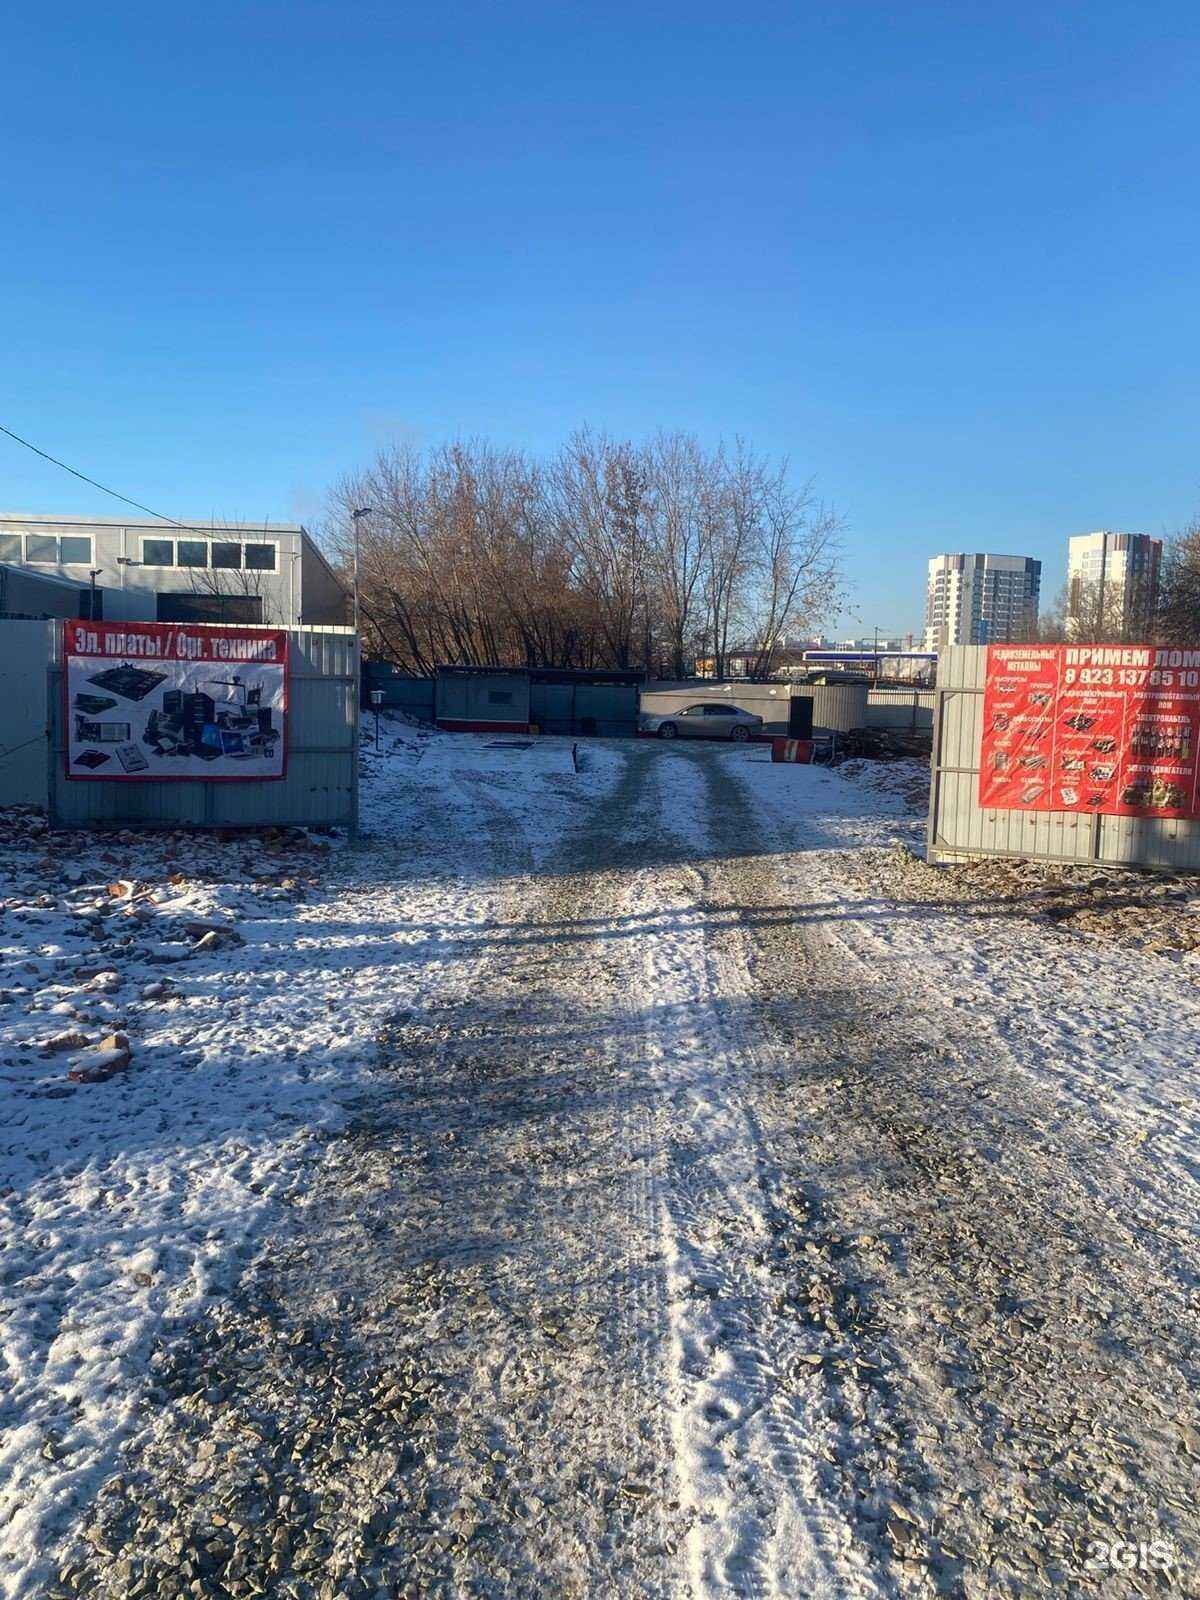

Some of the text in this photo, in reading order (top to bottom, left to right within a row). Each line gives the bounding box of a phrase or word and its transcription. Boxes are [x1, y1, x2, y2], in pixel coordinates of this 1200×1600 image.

[75, 627, 277, 660] Эл. платы / Орг. техника
[1065, 648, 1200, 667] ПРИМЕМ ЛОМ
[1065, 668, 1199, 688] 8 923 137 85 10
